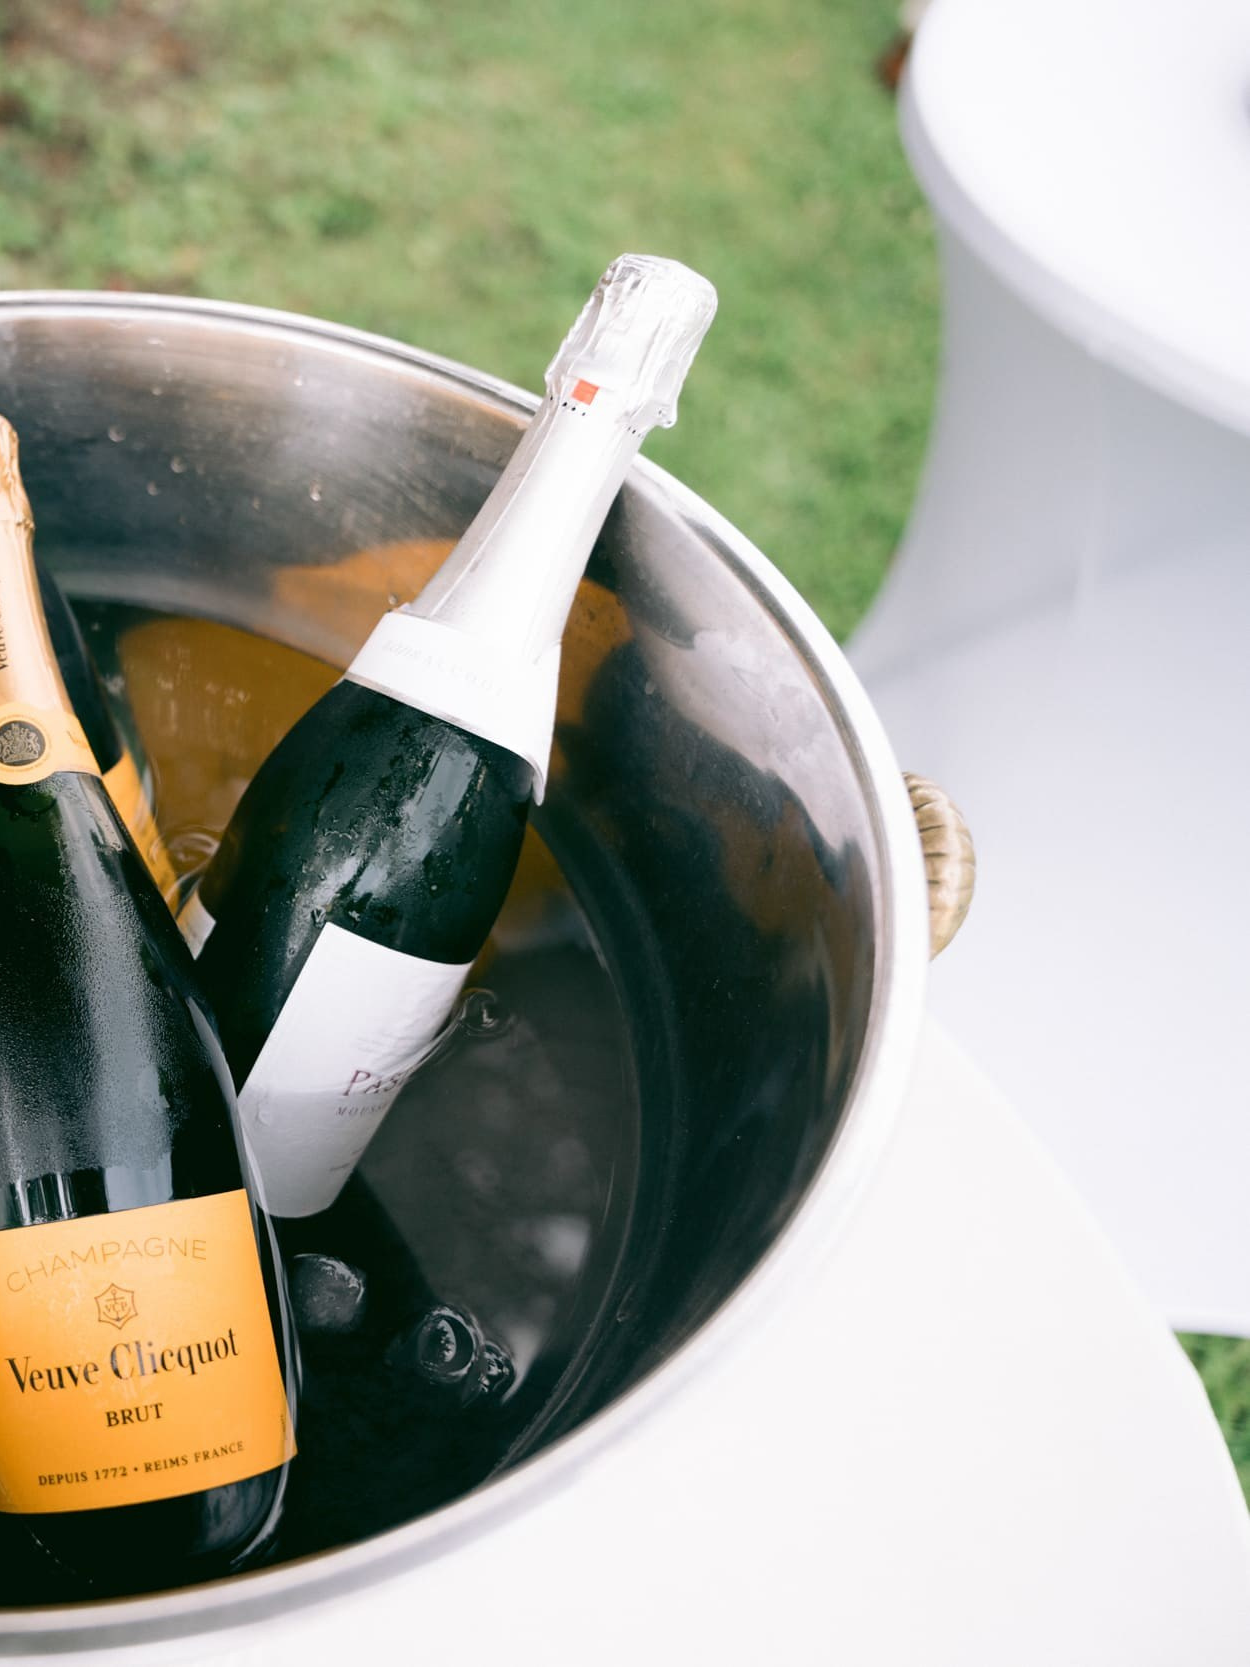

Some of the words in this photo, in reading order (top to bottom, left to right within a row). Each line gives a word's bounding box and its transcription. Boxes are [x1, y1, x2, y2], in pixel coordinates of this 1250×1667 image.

[6, 1236, 208, 1294] CHAMPAGNE
[5, 1355, 100, 1395] Veuve
[109, 1327, 239, 1381] Clicquot
[105, 1402, 164, 1428] BRUT
[38, 1471, 88, 1487] DEPUIS
[94, 1465, 128, 1481] 1772
[143, 1454, 189, 1474] REIMS
[193, 1440, 245, 1464] FRANCE
